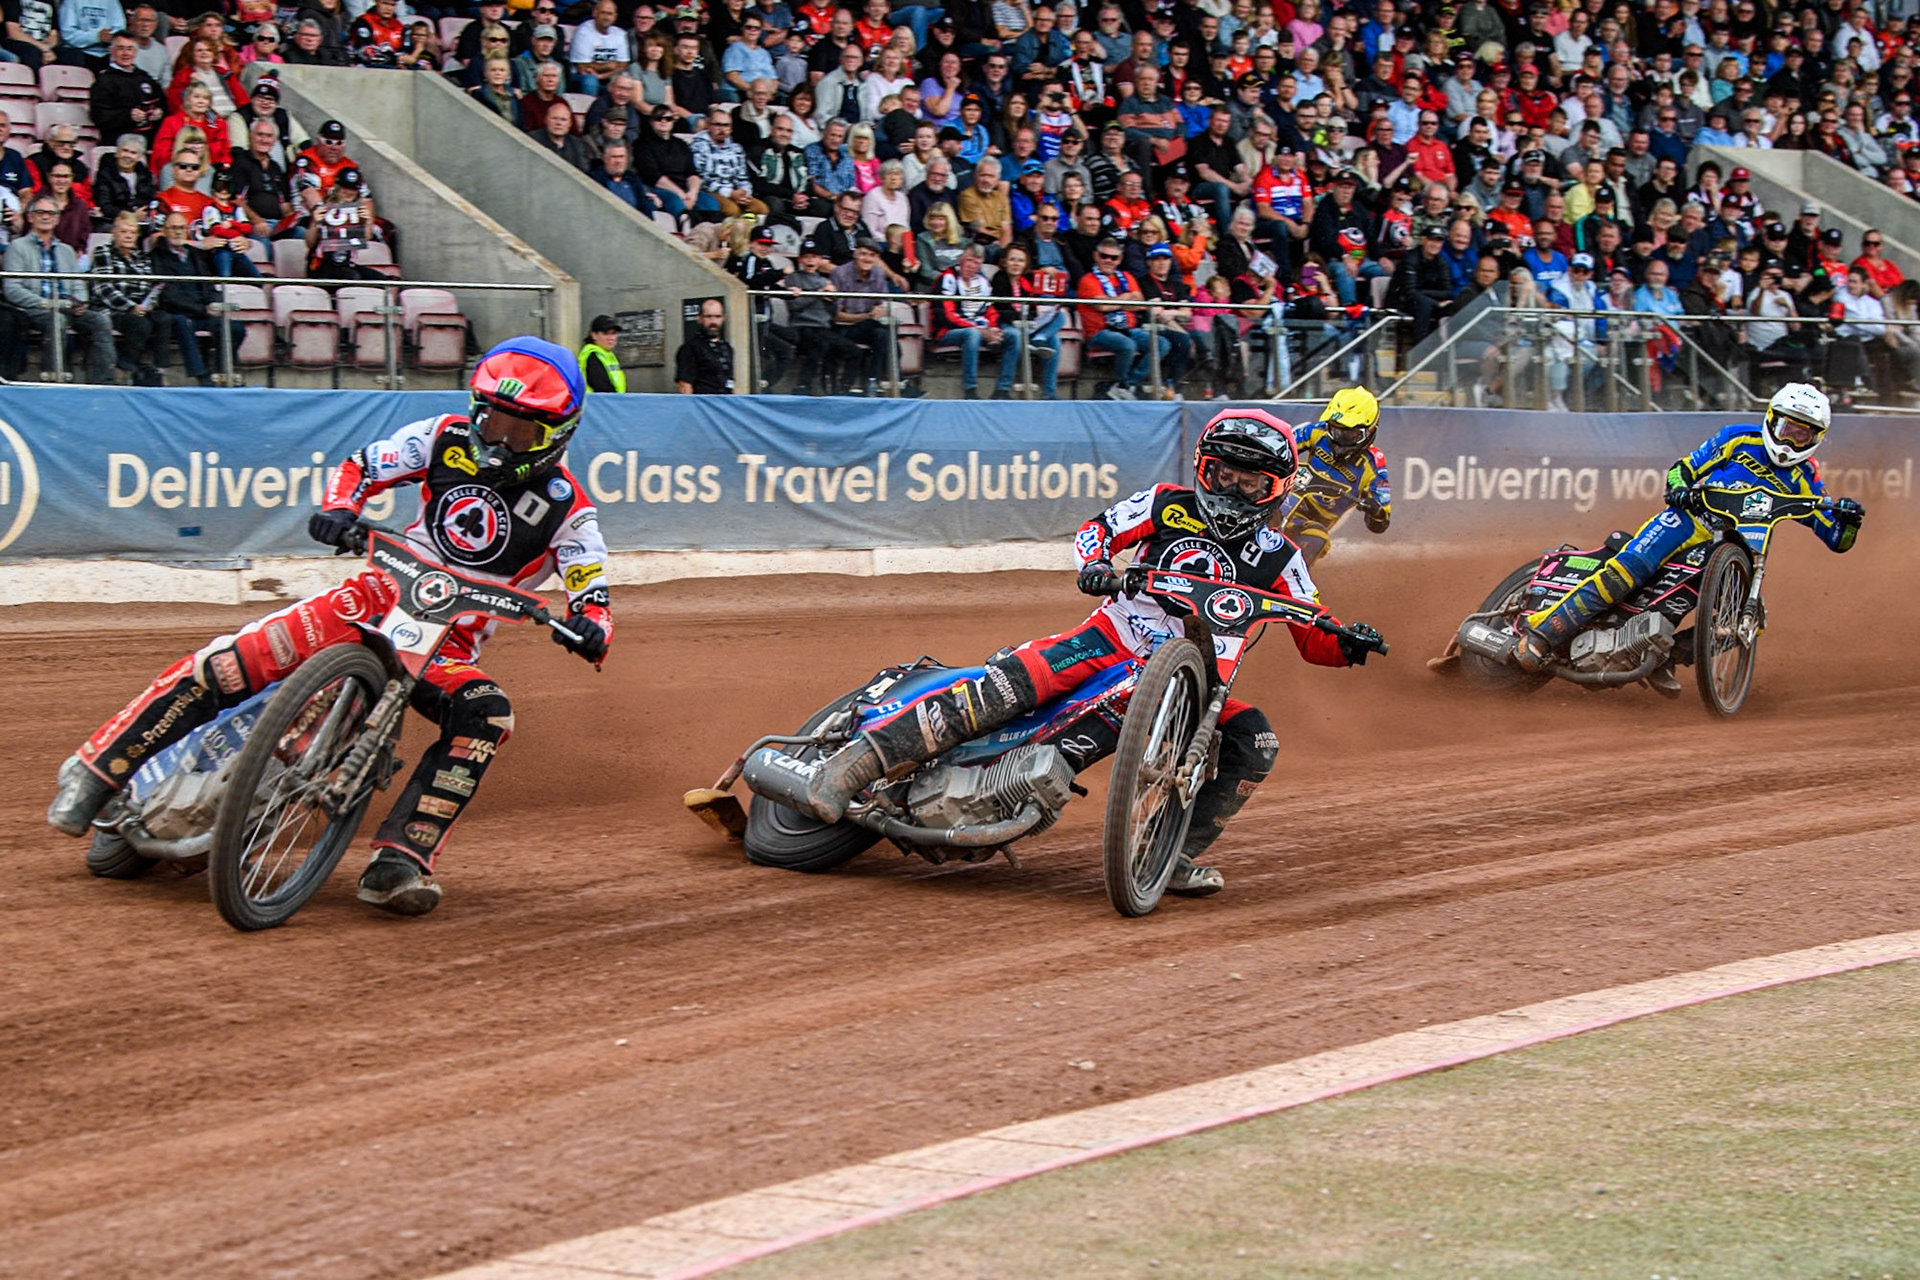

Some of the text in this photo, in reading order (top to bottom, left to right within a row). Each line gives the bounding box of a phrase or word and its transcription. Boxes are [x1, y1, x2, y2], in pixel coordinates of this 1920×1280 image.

[107, 451, 395, 521] Deliverig
[587, 450, 722, 503] Class
[736, 452, 889, 503] Travel
[905, 449, 1119, 502] Solutions
[1404, 455, 1600, 513] Delivering
[447, 487, 508, 537] BELLE VUE ACES
[1172, 541, 1202, 554] BELLE
[1205, 543, 1223, 562] VUE
[340, 593, 357, 615] ATPI
[395, 629, 418, 642] ATPI
[865, 676, 897, 699] 4
